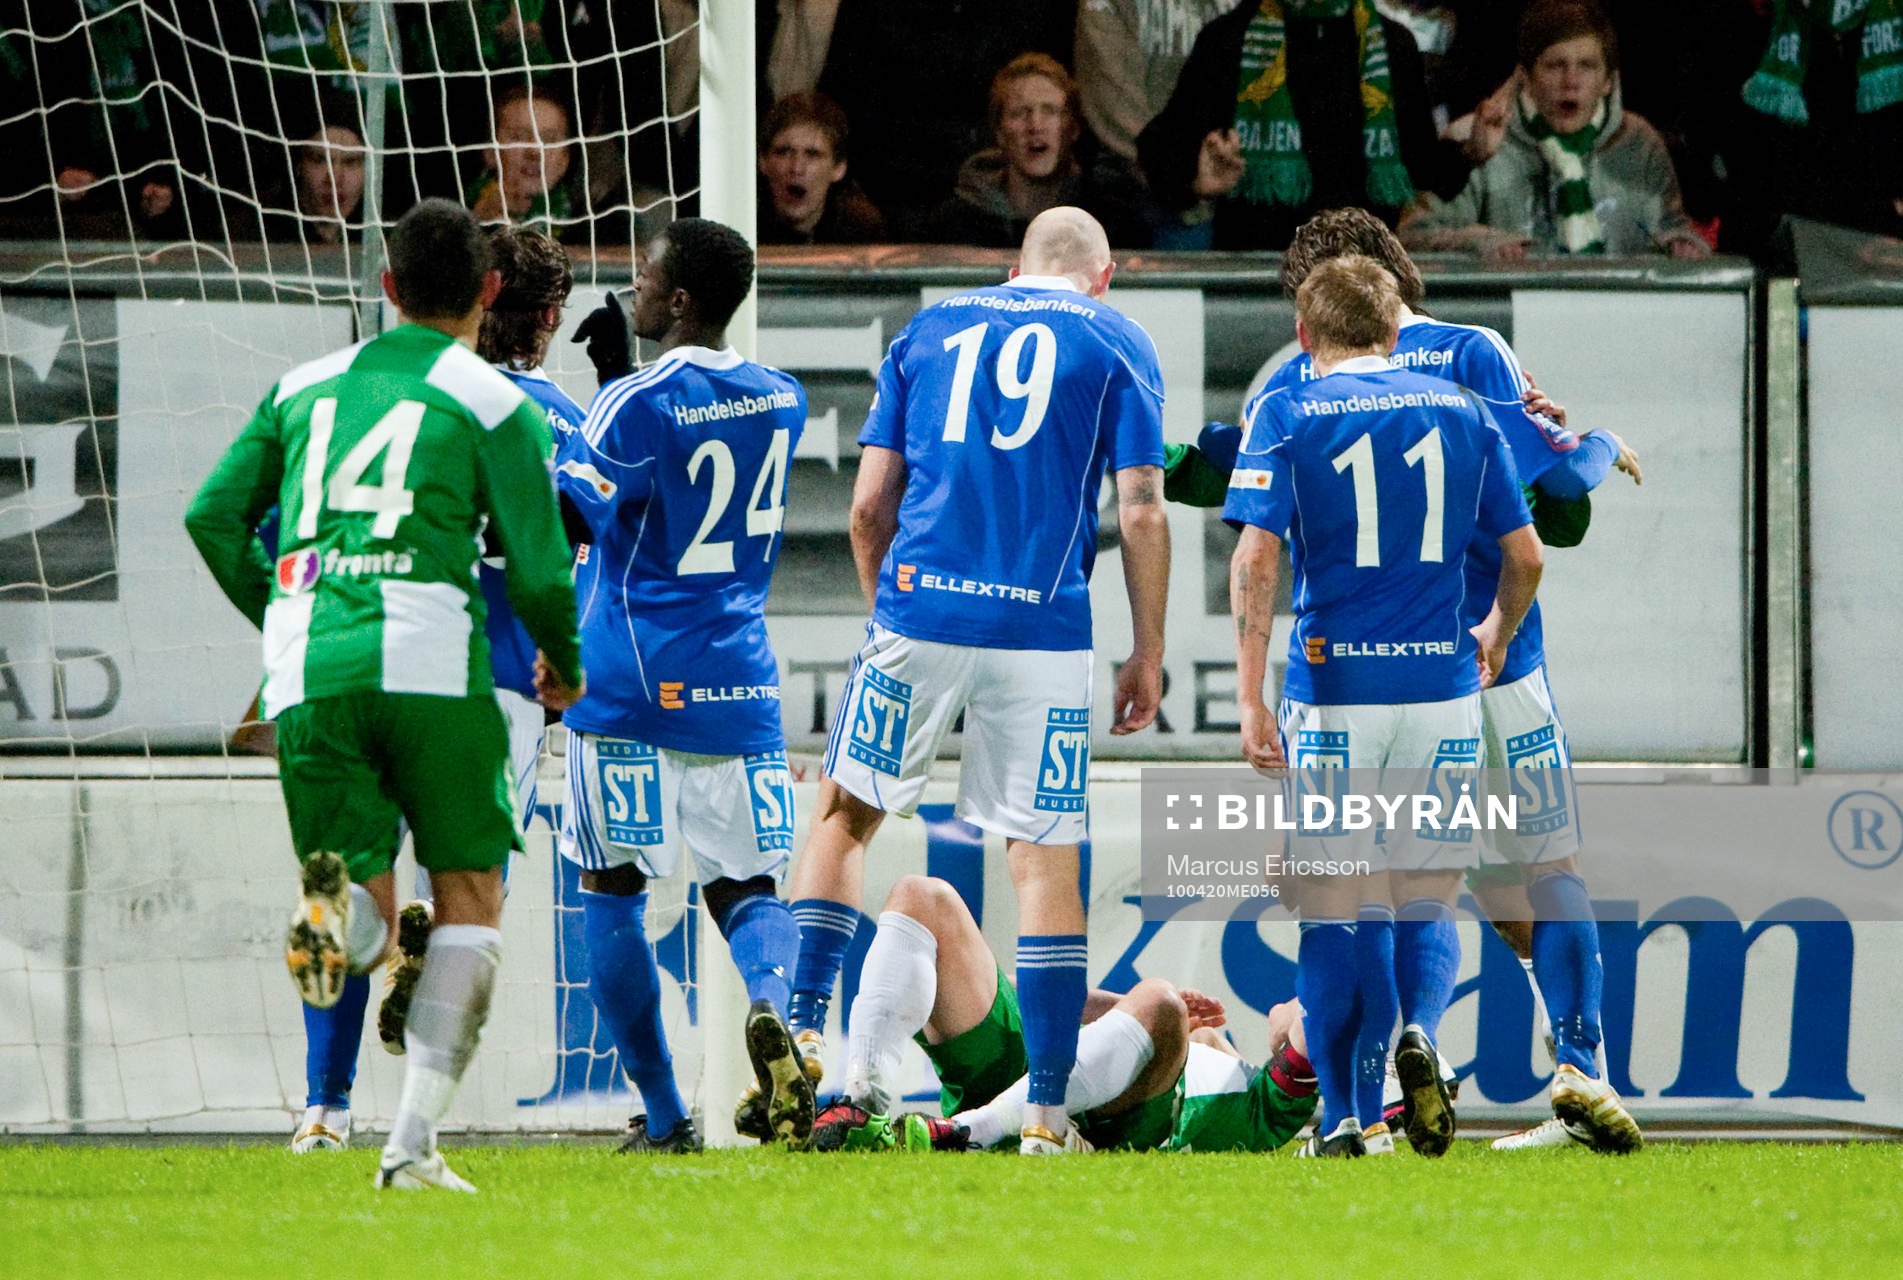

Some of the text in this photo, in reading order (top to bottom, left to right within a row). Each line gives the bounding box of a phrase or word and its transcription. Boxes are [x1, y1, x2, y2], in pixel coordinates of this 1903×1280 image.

[941, 295, 1097, 320] Handelsbanken
[673, 389, 799, 426] Handelsbanken
[941, 321, 1058, 451] 19
[1302, 389, 1467, 417] Handelsbanken
[296, 397, 427, 540] 14
[1331, 426, 1446, 568] 11
[676, 427, 790, 577] 24
[920, 573, 1042, 604] ELLEXTRE
[1332, 641, 1456, 657] ELLEXTRE
[856, 686, 905, 753] ST
[1510, 728, 1552, 749] MEDIE
[849, 745, 896, 773] HUSET
[1043, 730, 1087, 790] ST
[1515, 748, 1558, 815] ST
[604, 763, 654, 823] ST
[753, 768, 793, 828] ST
[1519, 815, 1566, 834] HUSET
